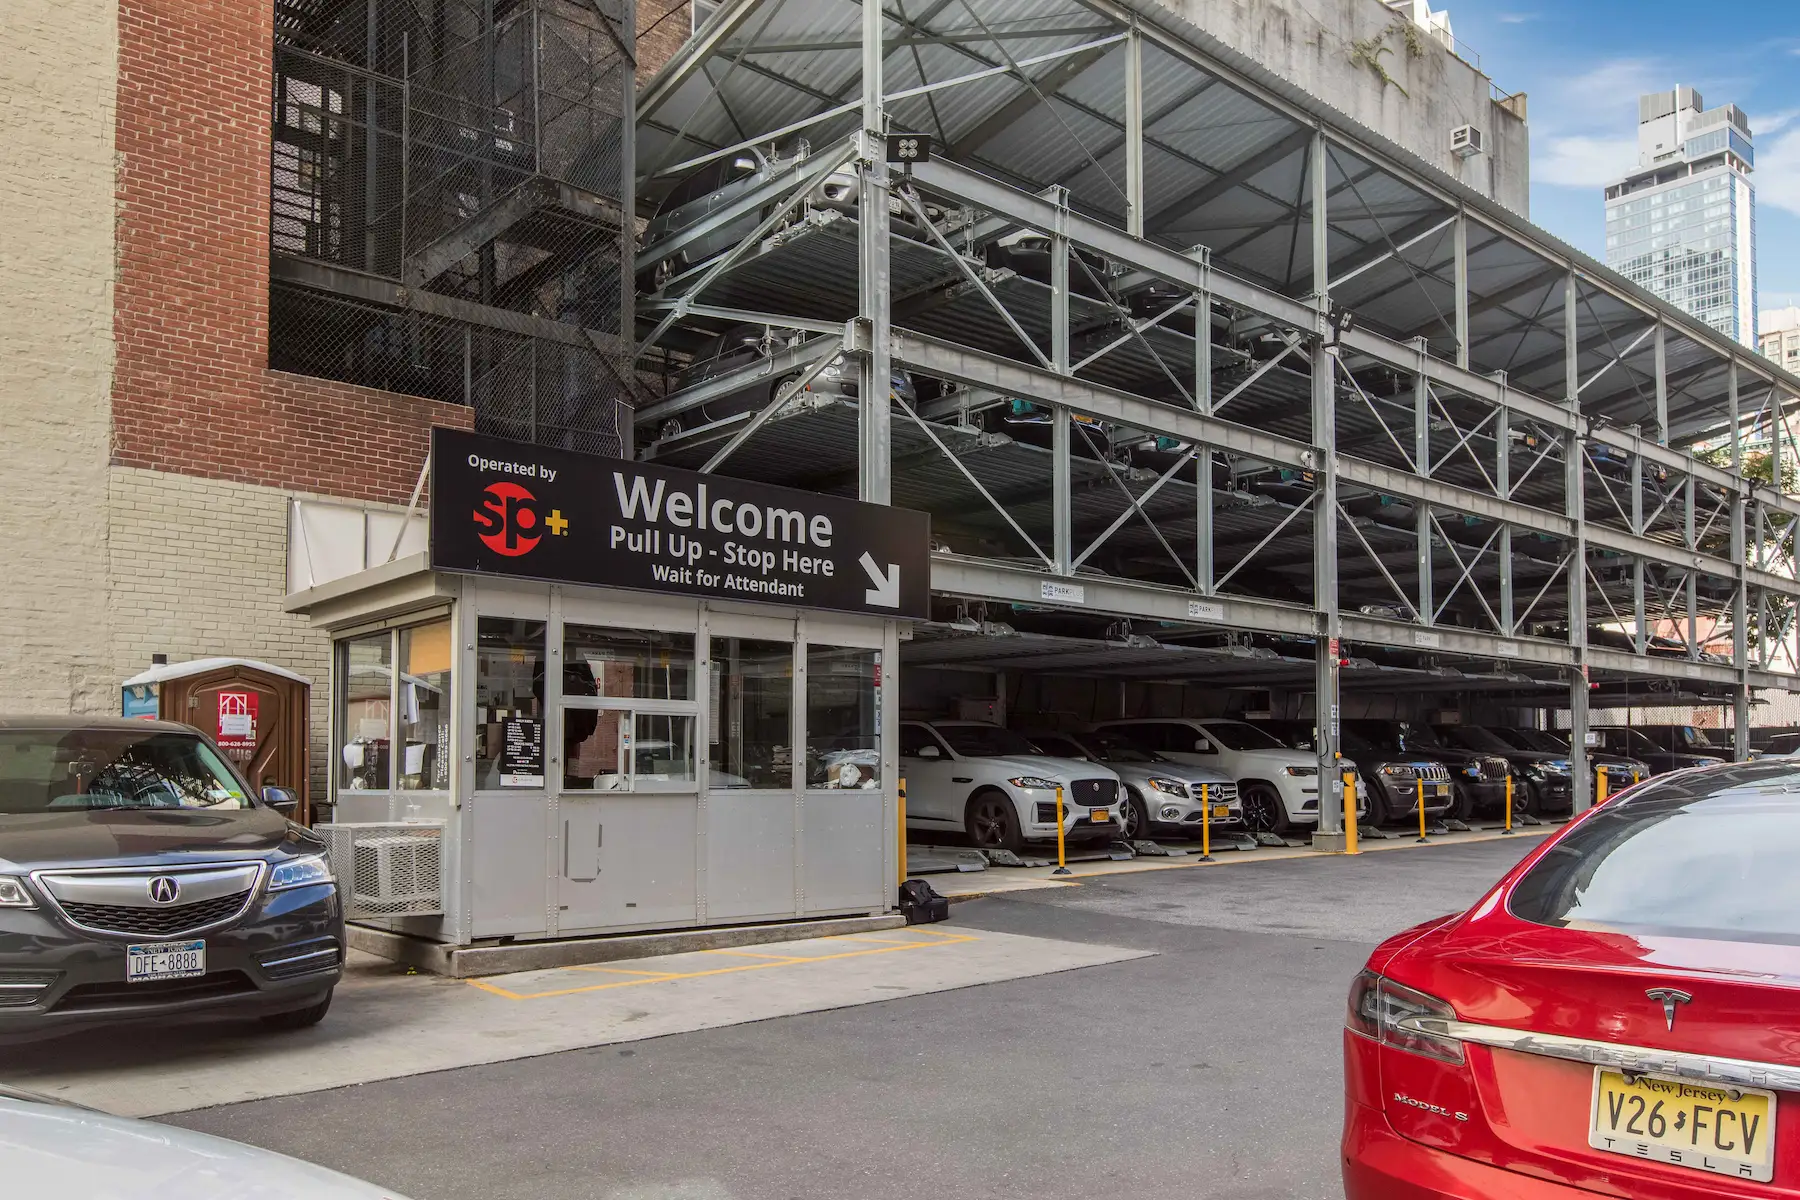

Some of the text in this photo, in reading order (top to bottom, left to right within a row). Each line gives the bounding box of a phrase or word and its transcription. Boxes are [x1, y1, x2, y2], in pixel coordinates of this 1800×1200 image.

[468, 454, 557, 482] Operated by
[613, 472, 833, 548] Welcome
[610, 525, 660, 554] Pull
[669, 533, 702, 566] Up
[723, 541, 775, 575] Stop
[782, 550, 834, 576] Here
[652, 564, 805, 598] Wait for Attendant
[132, 972, 201, 982] MANHATTAN
[135, 952, 197, 974] DFE 8888
[1638, 1076, 1726, 1105] New Jersey
[1393, 1092, 1469, 1121] MODEL S
[1608, 1091, 1760, 1155] V26 FCV
[1605, 1137, 1752, 1176] TESLA
